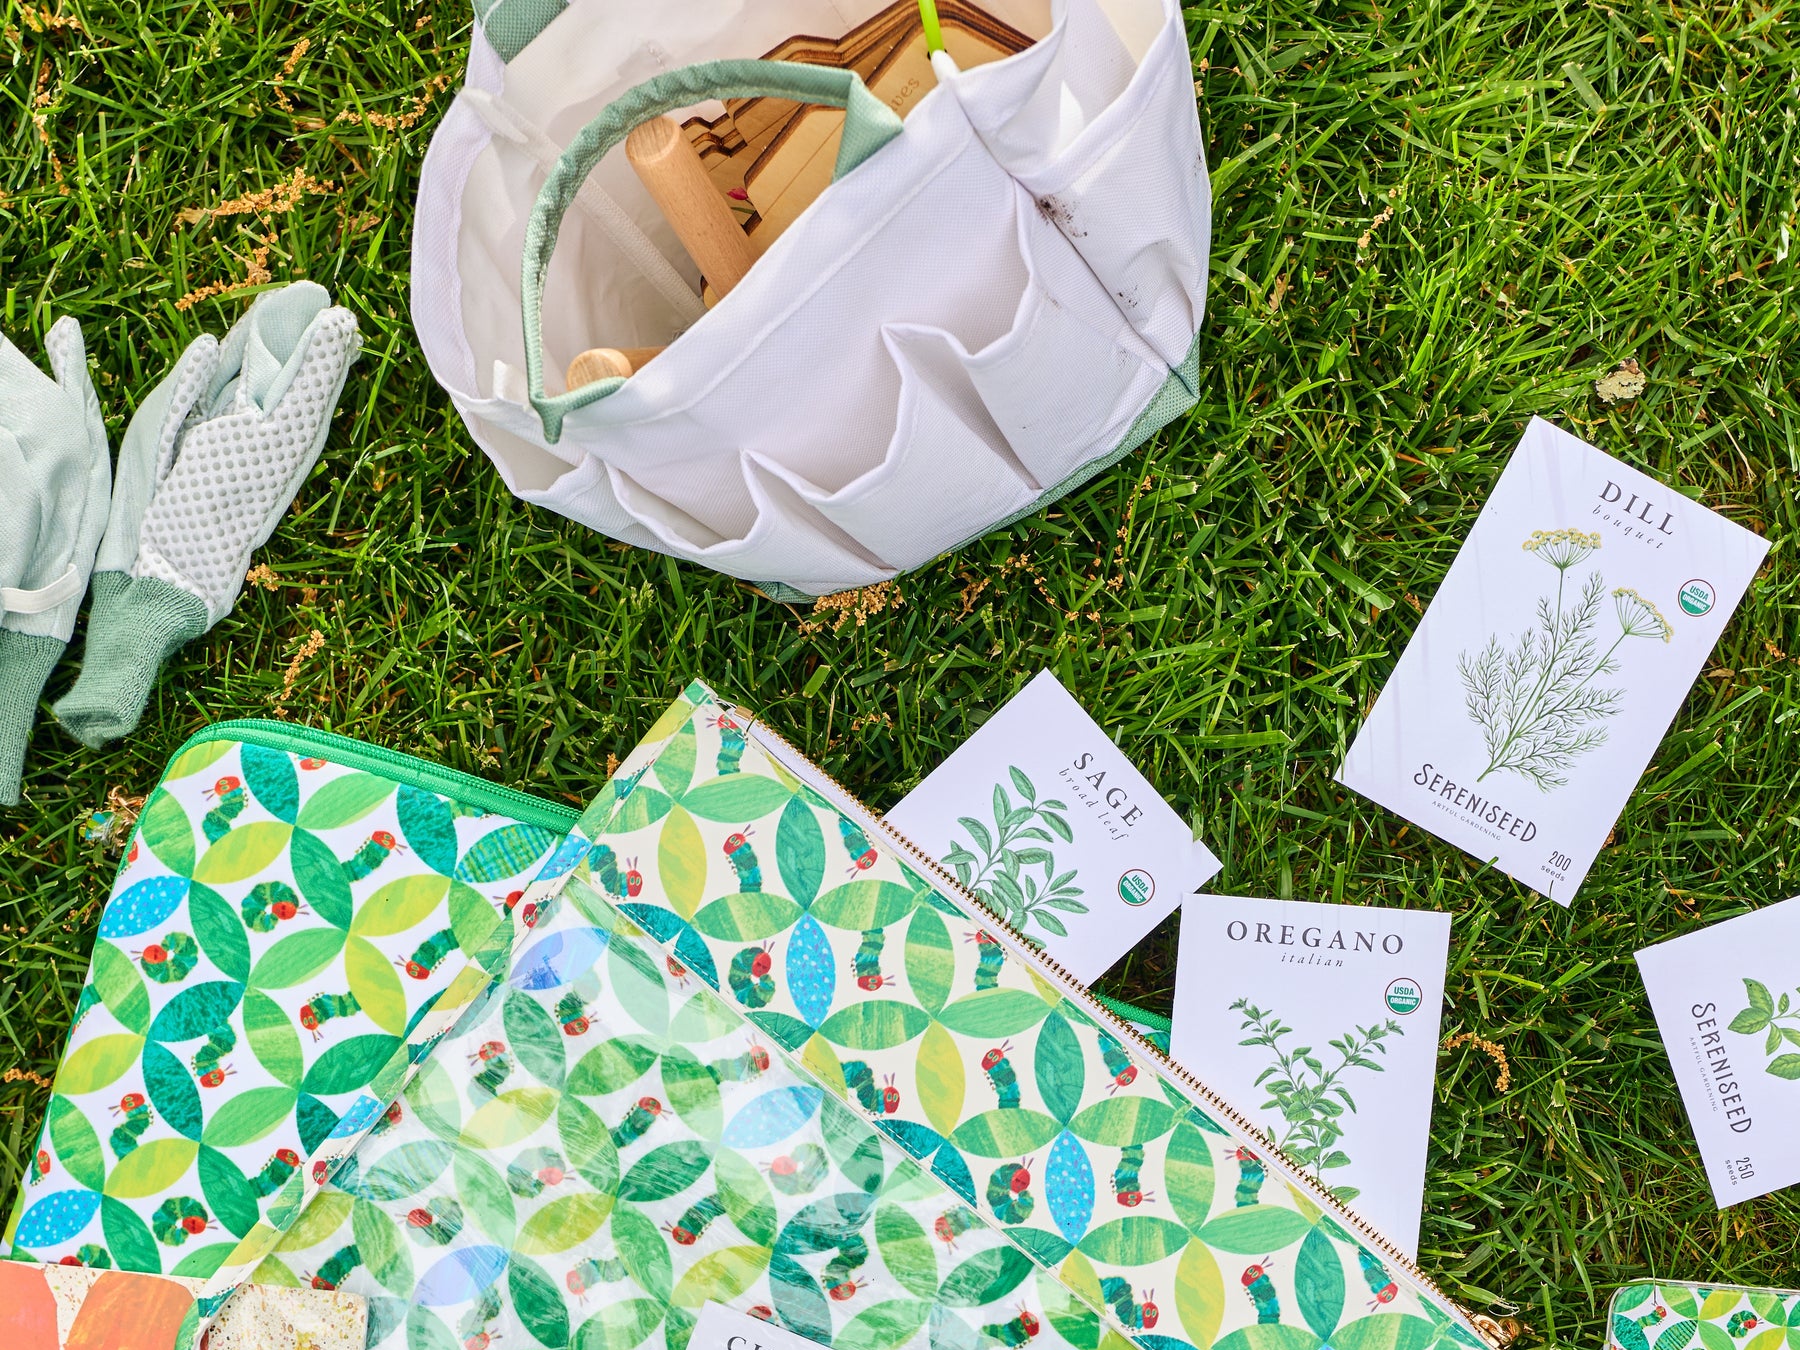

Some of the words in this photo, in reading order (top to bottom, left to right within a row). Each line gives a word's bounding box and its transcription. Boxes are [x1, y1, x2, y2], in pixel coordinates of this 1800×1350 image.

[1598, 480, 1674, 536] DILL
[1592, 504, 1664, 549] bouquet
[1682, 593, 1707, 611] ORGANIC
[1689, 586, 1709, 602] USDA
[1073, 752, 1143, 827] SAGE
[1413, 763, 1537, 842] SERENISEED
[1058, 768, 1099, 808] broad
[1098, 812, 1129, 841] leaf
[1431, 800, 1459, 818] ARTFUL
[1460, 815, 1501, 841] GARDENING
[1540, 864, 1566, 882] seeds
[1548, 850, 1572, 872] 200
[1124, 880, 1143, 902] ORGANIC
[1131, 874, 1149, 894] USDA
[1226, 920, 1404, 955] OREGANO
[1281, 951, 1345, 968] italian
[1390, 996, 1417, 1006] ORGANIC
[1393, 986, 1415, 996] USDA
[1689, 1036, 1702, 1065] ARTFUL
[1699, 1066, 1719, 1113] GARDENING
[1691, 1002, 1752, 1133] SERENISEED
[1724, 1159, 1738, 1187] seeds
[1735, 1156, 1755, 1180] 250
